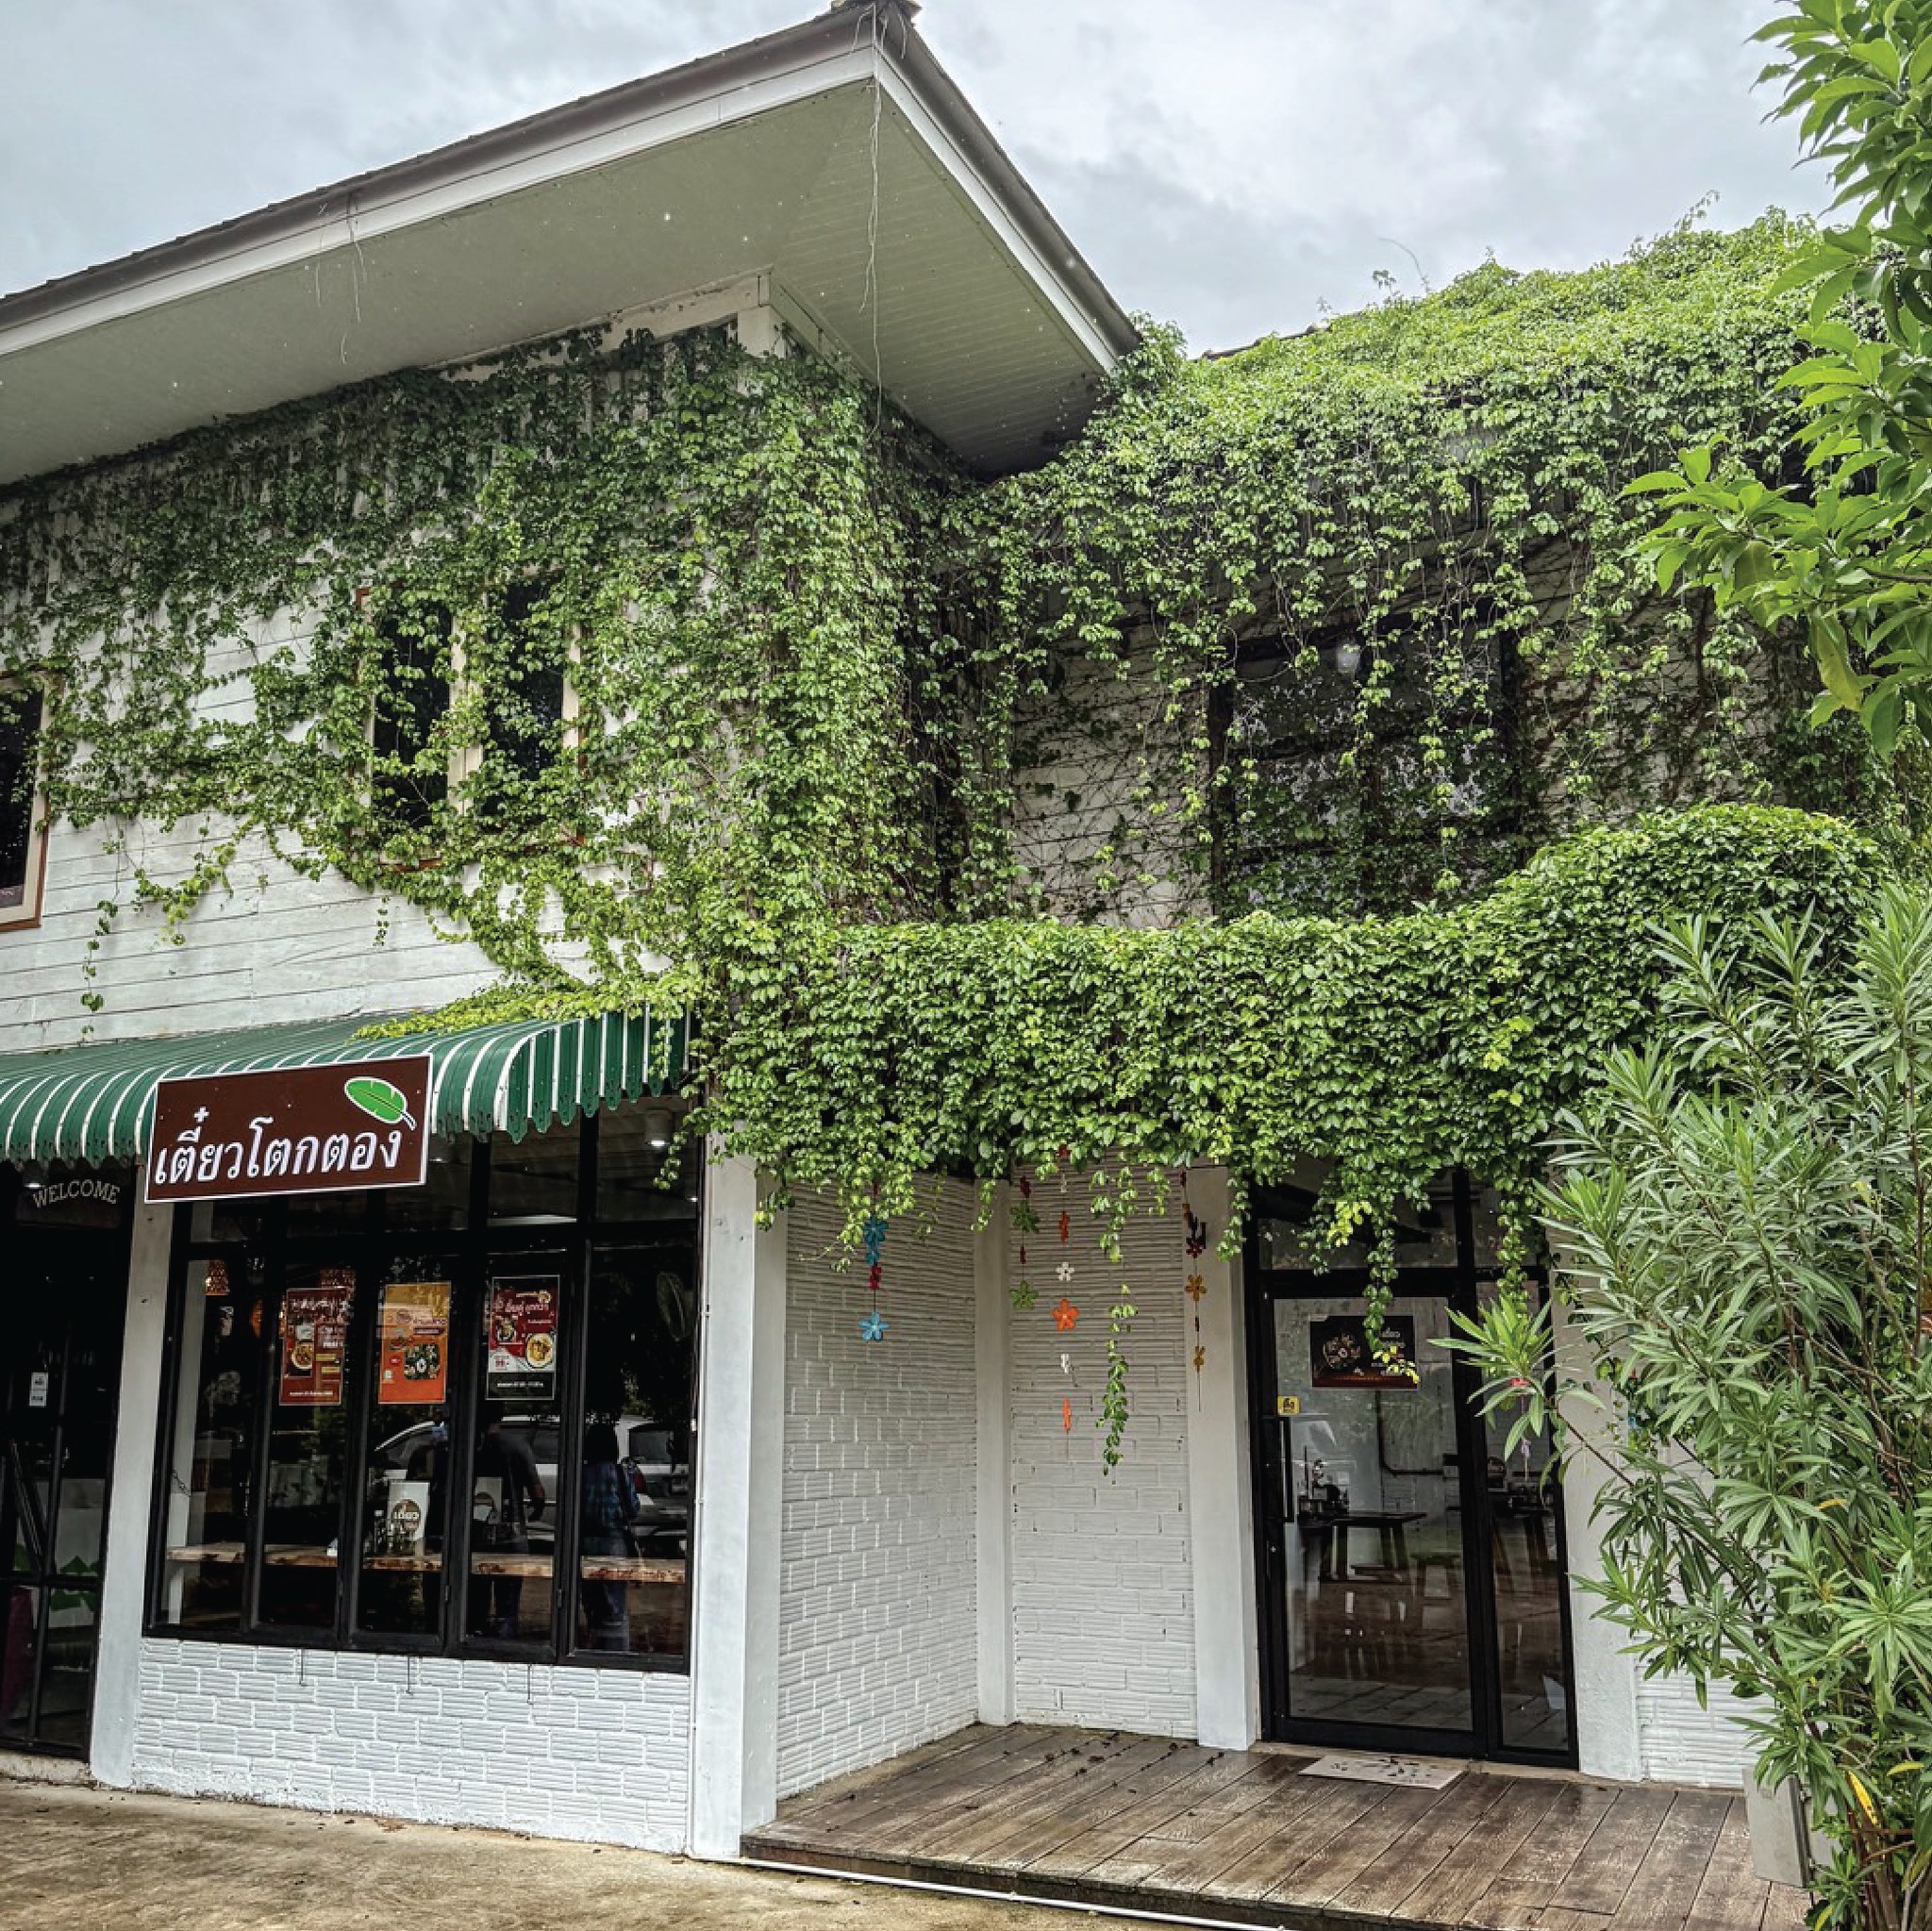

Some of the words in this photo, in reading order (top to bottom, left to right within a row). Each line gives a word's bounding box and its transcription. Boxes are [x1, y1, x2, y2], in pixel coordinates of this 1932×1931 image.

[155, 1106, 403, 1185] เตี๋ยวโตกตอง
[32, 1179, 121, 1207] WELCOME
